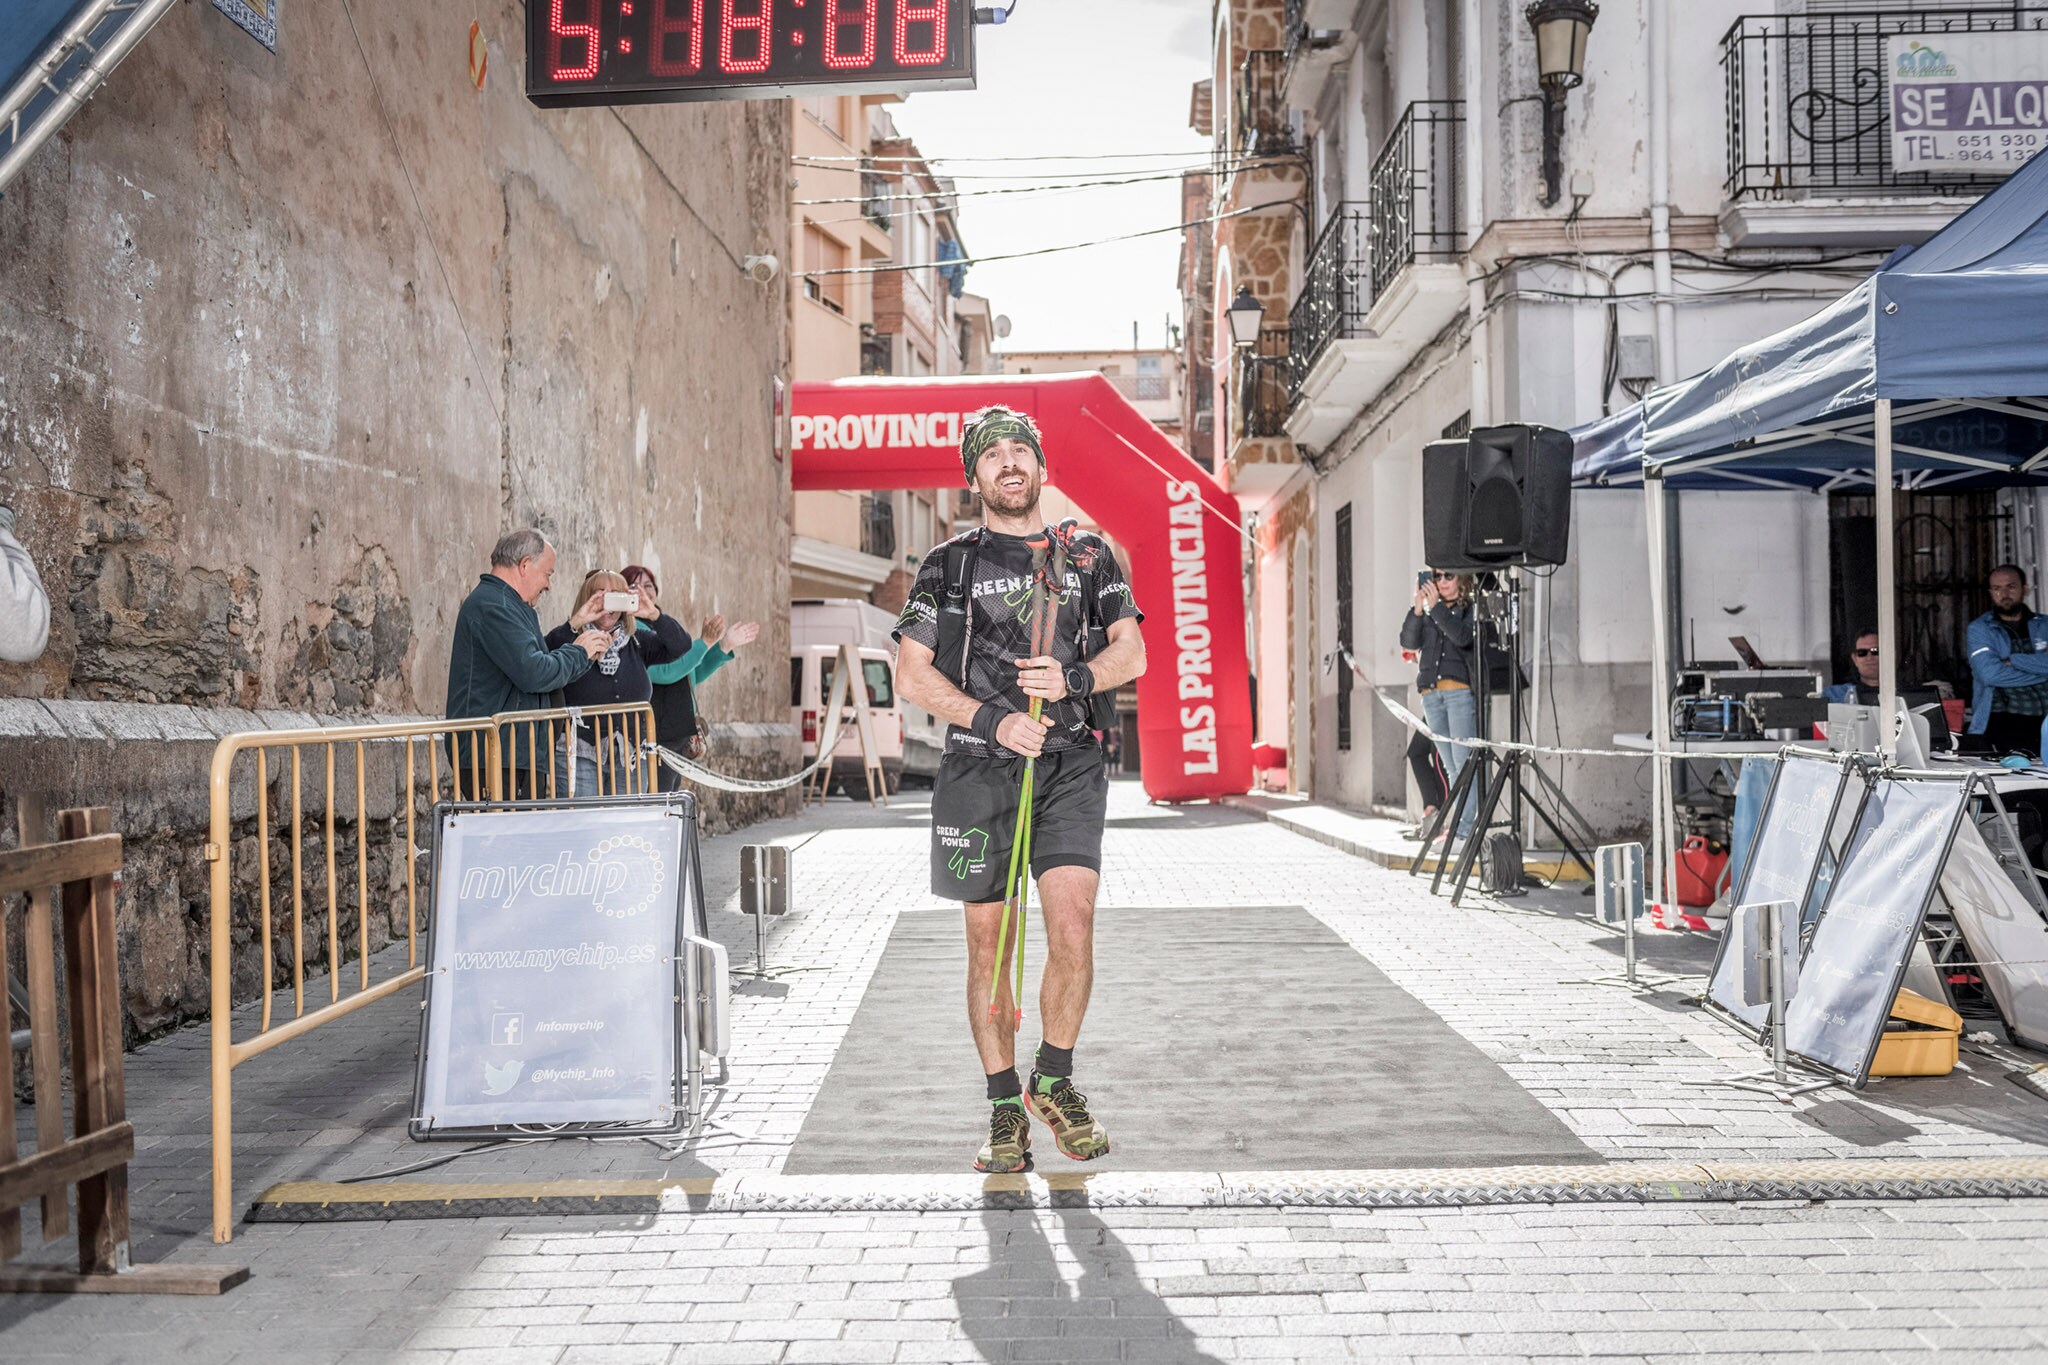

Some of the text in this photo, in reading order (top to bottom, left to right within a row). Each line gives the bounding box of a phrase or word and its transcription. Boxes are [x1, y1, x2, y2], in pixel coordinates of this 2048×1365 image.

[1901, 85, 2048, 127] SE ALQ
[1957, 135, 1992, 147] 651
[2001, 133, 2037, 147] 930
[1958, 150, 1994, 161] 964
[790, 411, 965, 450] PROVINCI
[971, 575, 1022, 599] REEN
[1165, 479, 1219, 777] LAS PROVINCIAS
[936, 825, 960, 838] GREEN
[941, 837, 971, 848] POWER
[459, 850, 628, 908] mychip
[454, 942, 657, 972] www.mychip.es
[531, 1067, 616, 1083] @Mychip_Info
